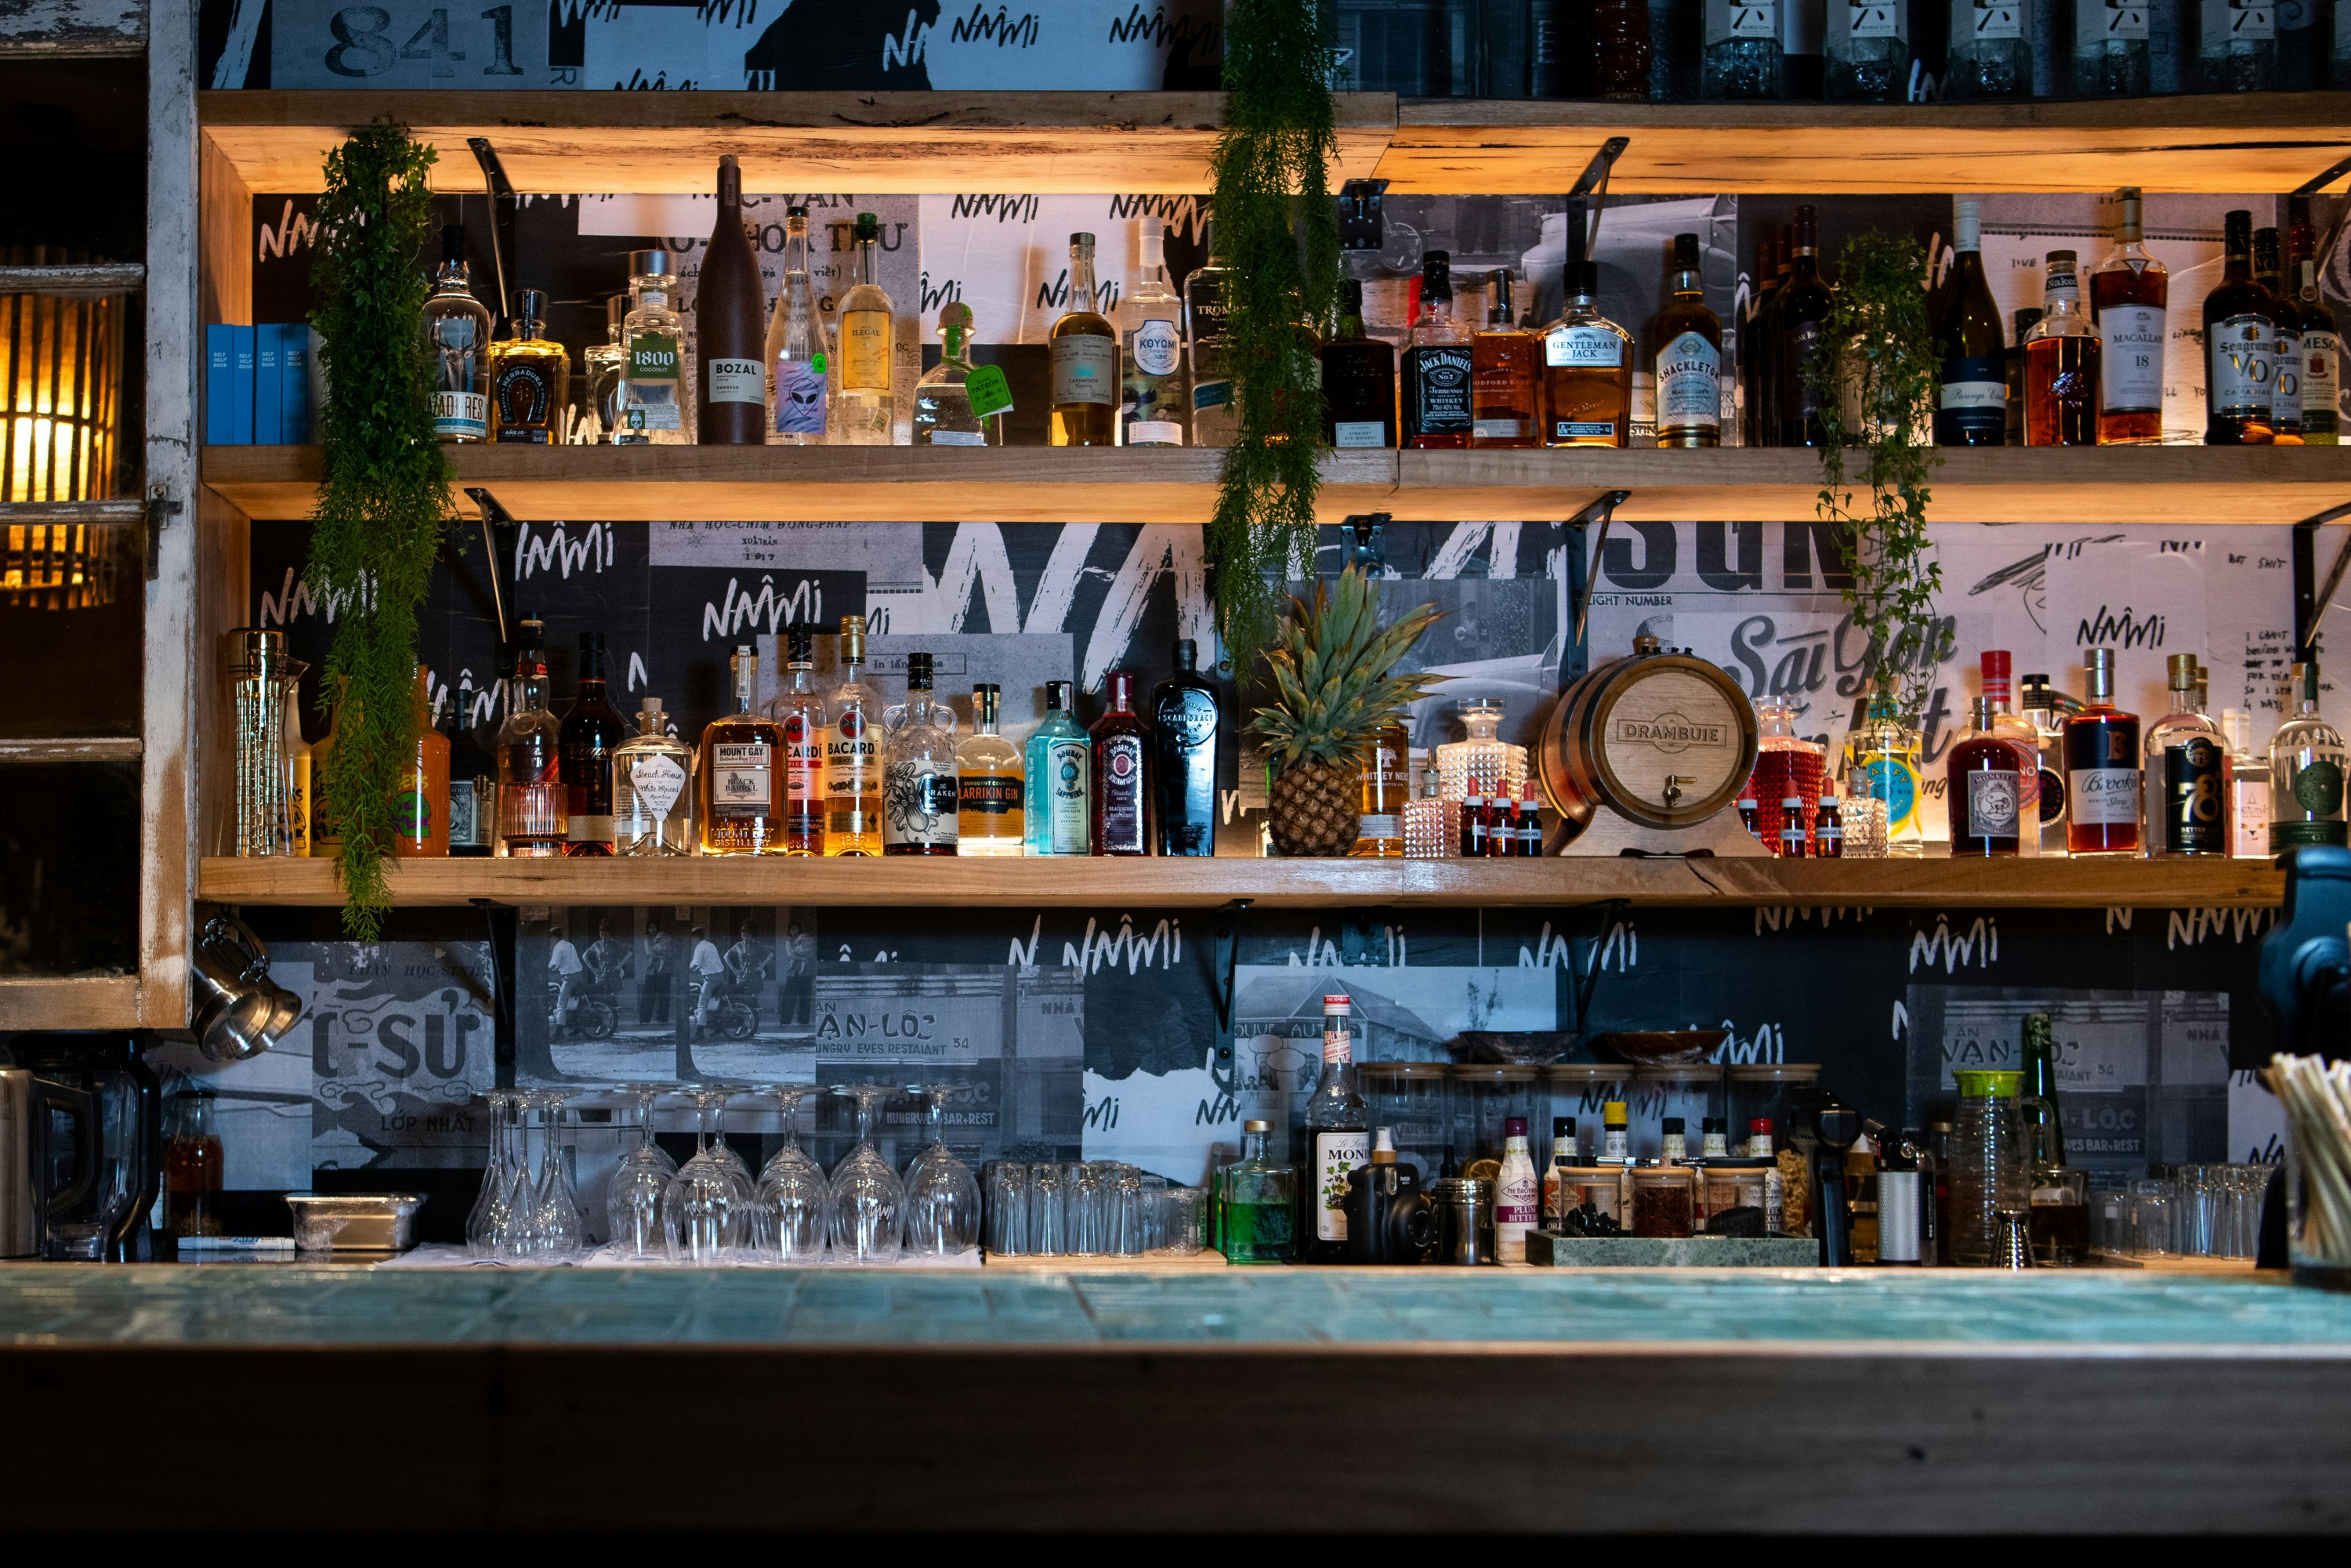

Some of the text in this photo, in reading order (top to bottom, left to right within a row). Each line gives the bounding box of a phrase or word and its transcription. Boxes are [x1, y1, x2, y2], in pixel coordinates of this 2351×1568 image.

[324, 5, 524, 78] 841
[2113, 333, 2163, 343] MACALLAN
[635, 351, 674, 366] 1800
[1420, 353, 1472, 373] JACK DANIEL'S
[2135, 355, 2150, 367] 18
[715, 364, 757, 375] BOZAL
[1659, 360, 1719, 382] SHACKLETON
[2228, 353, 2269, 383] VO
[502, 369, 544, 387] HERRADURA
[1625, 596, 1672, 606] NUMBER
[1624, 724, 1719, 742] DRAMBUIE
[788, 744, 823, 759] CARDÍ
[1109, 744, 1136, 758] BOMBAY
[2106, 730, 2127, 760] B
[719, 748, 763, 756] MOUNT GAY
[1056, 749, 1083, 762] BOMBAY
[636, 769, 683, 780] Beach House
[1108, 774, 1137, 785] BRAMBLE
[1871, 767, 1909, 783] ALFY
[639, 783, 679, 794] White Spiced
[959, 787, 1018, 800] LARRIKIN GIN
[1056, 787, 1085, 798] SAPPHIRE
[1291, 1023, 1357, 1037] AUTS
[816, 1043, 884, 1054] UNGRY EYES
[1328, 1149, 1370, 1160] MONI
